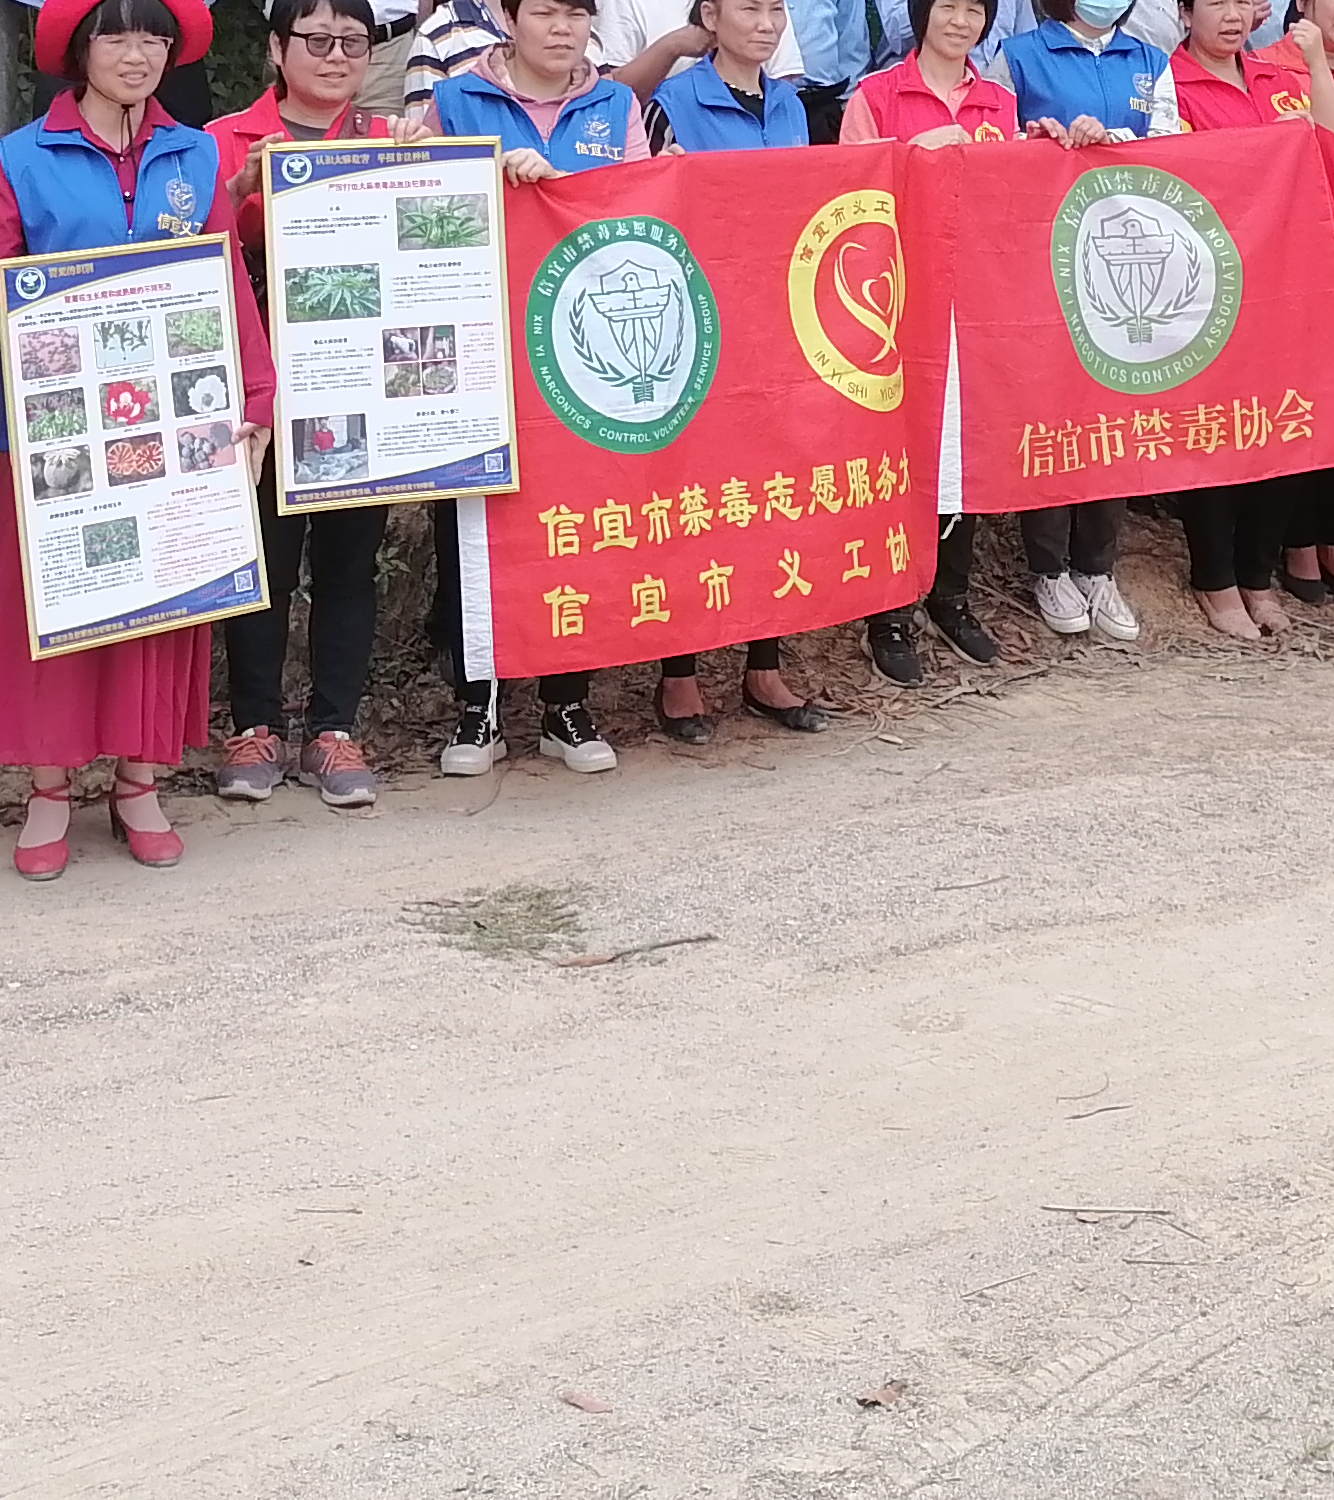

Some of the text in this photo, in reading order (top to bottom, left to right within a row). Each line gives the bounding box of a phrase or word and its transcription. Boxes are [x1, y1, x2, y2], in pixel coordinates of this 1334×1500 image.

[1062, 171, 1205, 229] 信宜市禁毒协会
[533, 314, 543, 335] XIN
[698, 293, 713, 335] GROUP
[1058, 244, 1071, 277] XIN
[1070, 313, 1127, 383] NARCOTICS
[1131, 350, 1204, 385] CONTROL
[1204, 227, 1236, 349] ASSOCIATION
[535, 344, 546, 357] YI
[693, 341, 713, 391] SERVICE
[847, 381, 868, 399] SHI
[598, 426, 652, 443] CONTROL
[653, 396, 696, 440] VOLUNTEER
[1017, 389, 1315, 479] 信宜市禁毒协会
